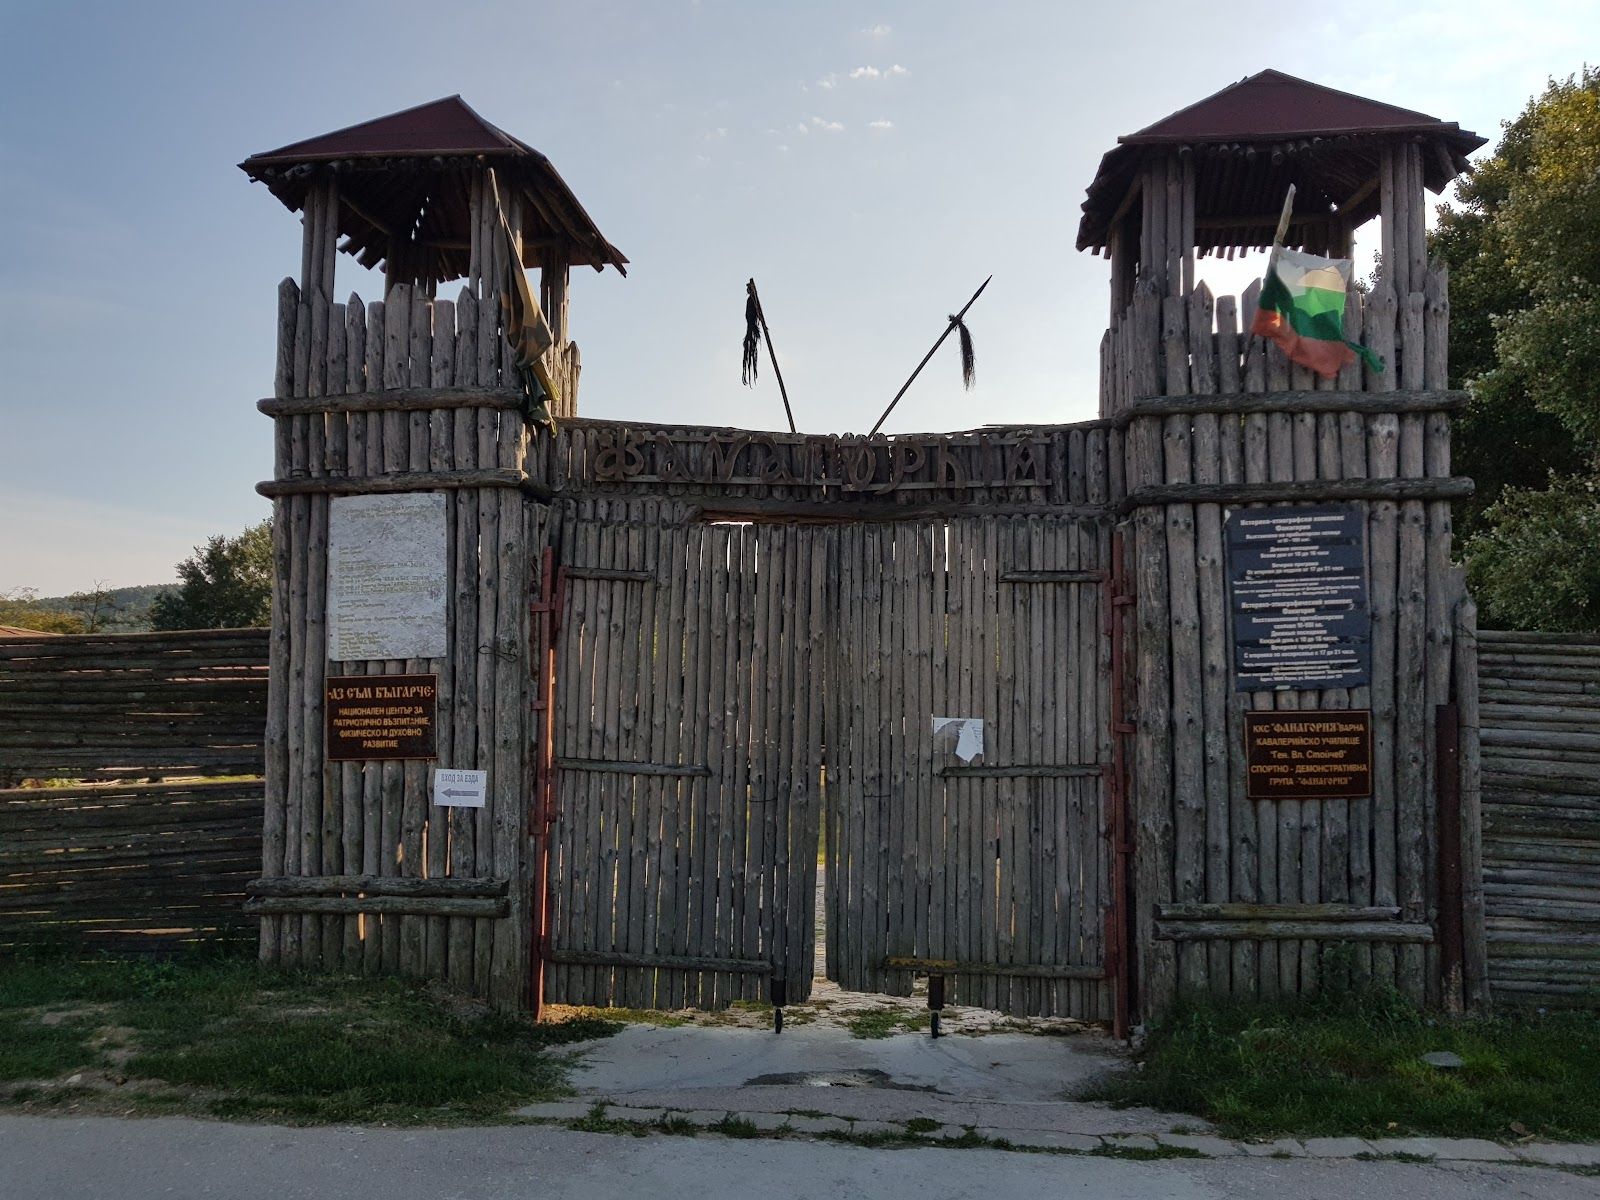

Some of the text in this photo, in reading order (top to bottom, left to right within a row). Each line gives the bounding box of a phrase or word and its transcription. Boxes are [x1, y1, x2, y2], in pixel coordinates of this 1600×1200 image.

[346, 687, 372, 699] СЪМ
[339, 706, 424, 716] НАЦИОНАЛЕН ЦЕНТЪР ЗА
[333, 718, 382, 727] ПАТРИОТИЧНО
[1339, 723, 1365, 732] ВАРНА
[339, 728, 422, 738] ФИЗИЧЕСКО И ДУХОВНО
[362, 740, 398, 748] РАЗВИТИЕ
[1256, 736, 1360, 746] КАВАЛЕРИЙСКО УЧИЛИЩЕ
[1250, 765, 1289, 773] СПОРТНО
[1295, 764, 1368, 774] ДЕМОНСТРАТИВНА
[456, 774, 464, 783] ЗА
[464, 774, 479, 784] ЕЗДА
[1269, 777, 1294, 786] ГРУПА
